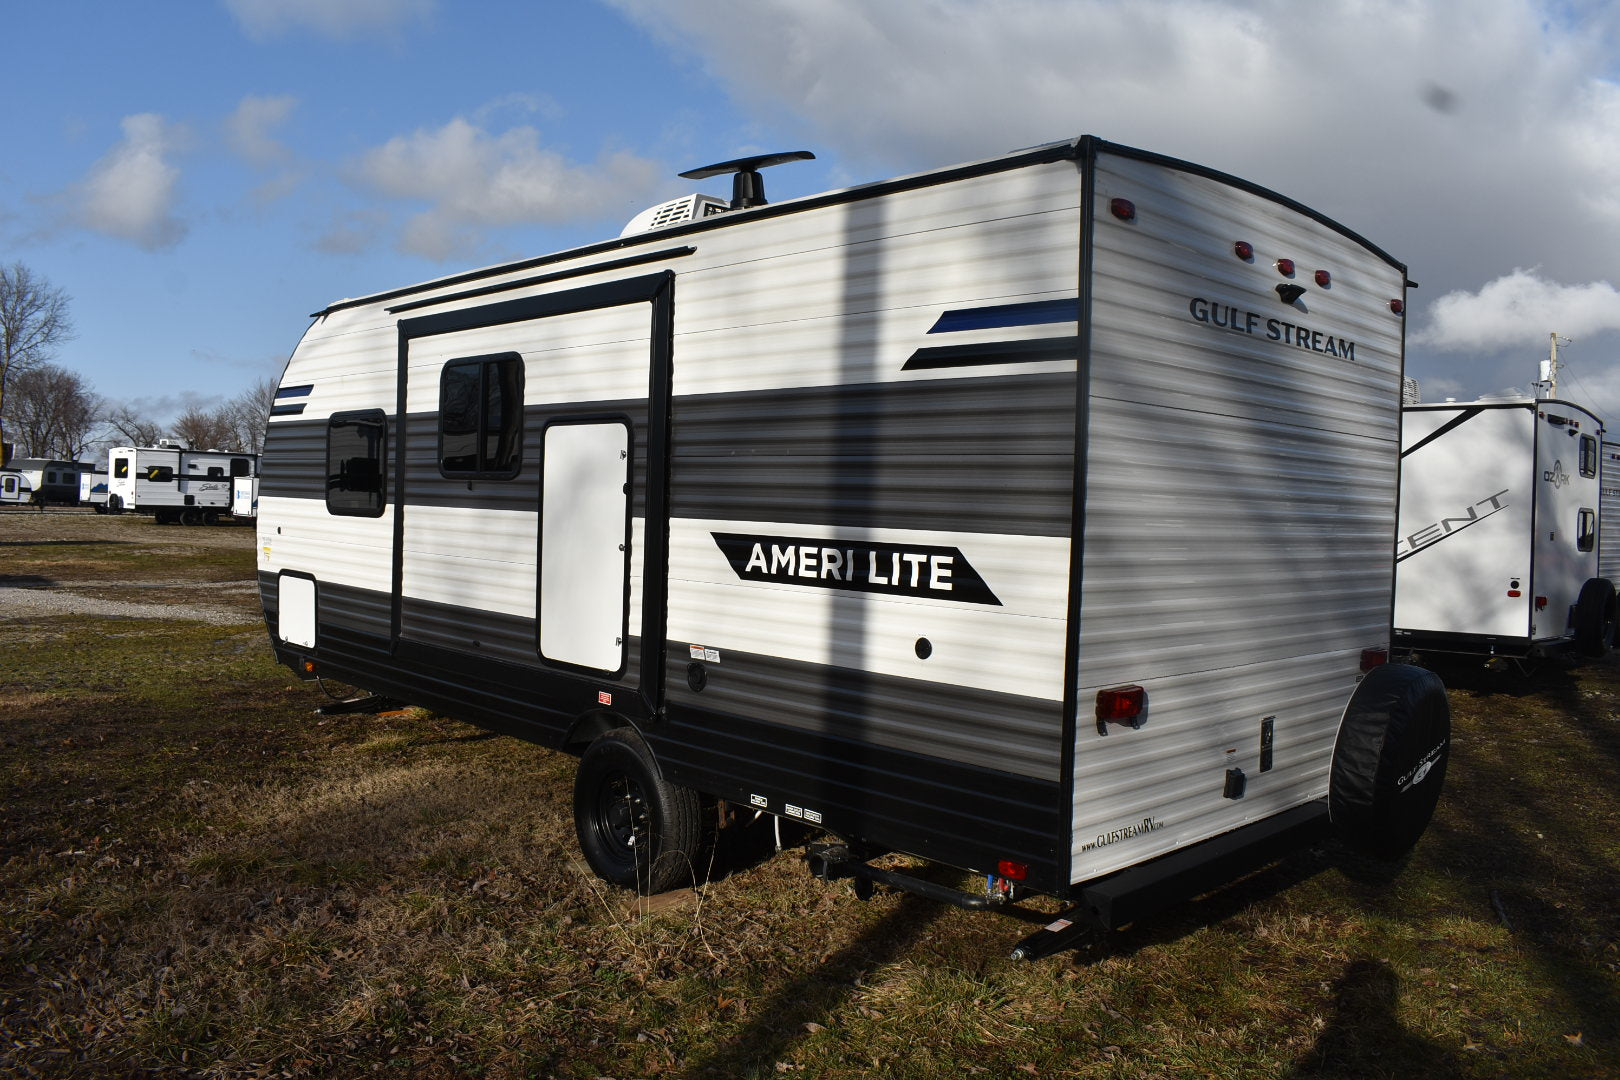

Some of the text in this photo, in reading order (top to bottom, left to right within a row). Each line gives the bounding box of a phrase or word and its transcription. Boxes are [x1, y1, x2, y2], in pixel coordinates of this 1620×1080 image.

[1189, 297, 1356, 361] GULF STREAM
[1397, 488, 1509, 556] ENT
[745, 542, 954, 591] AMERI LITE
